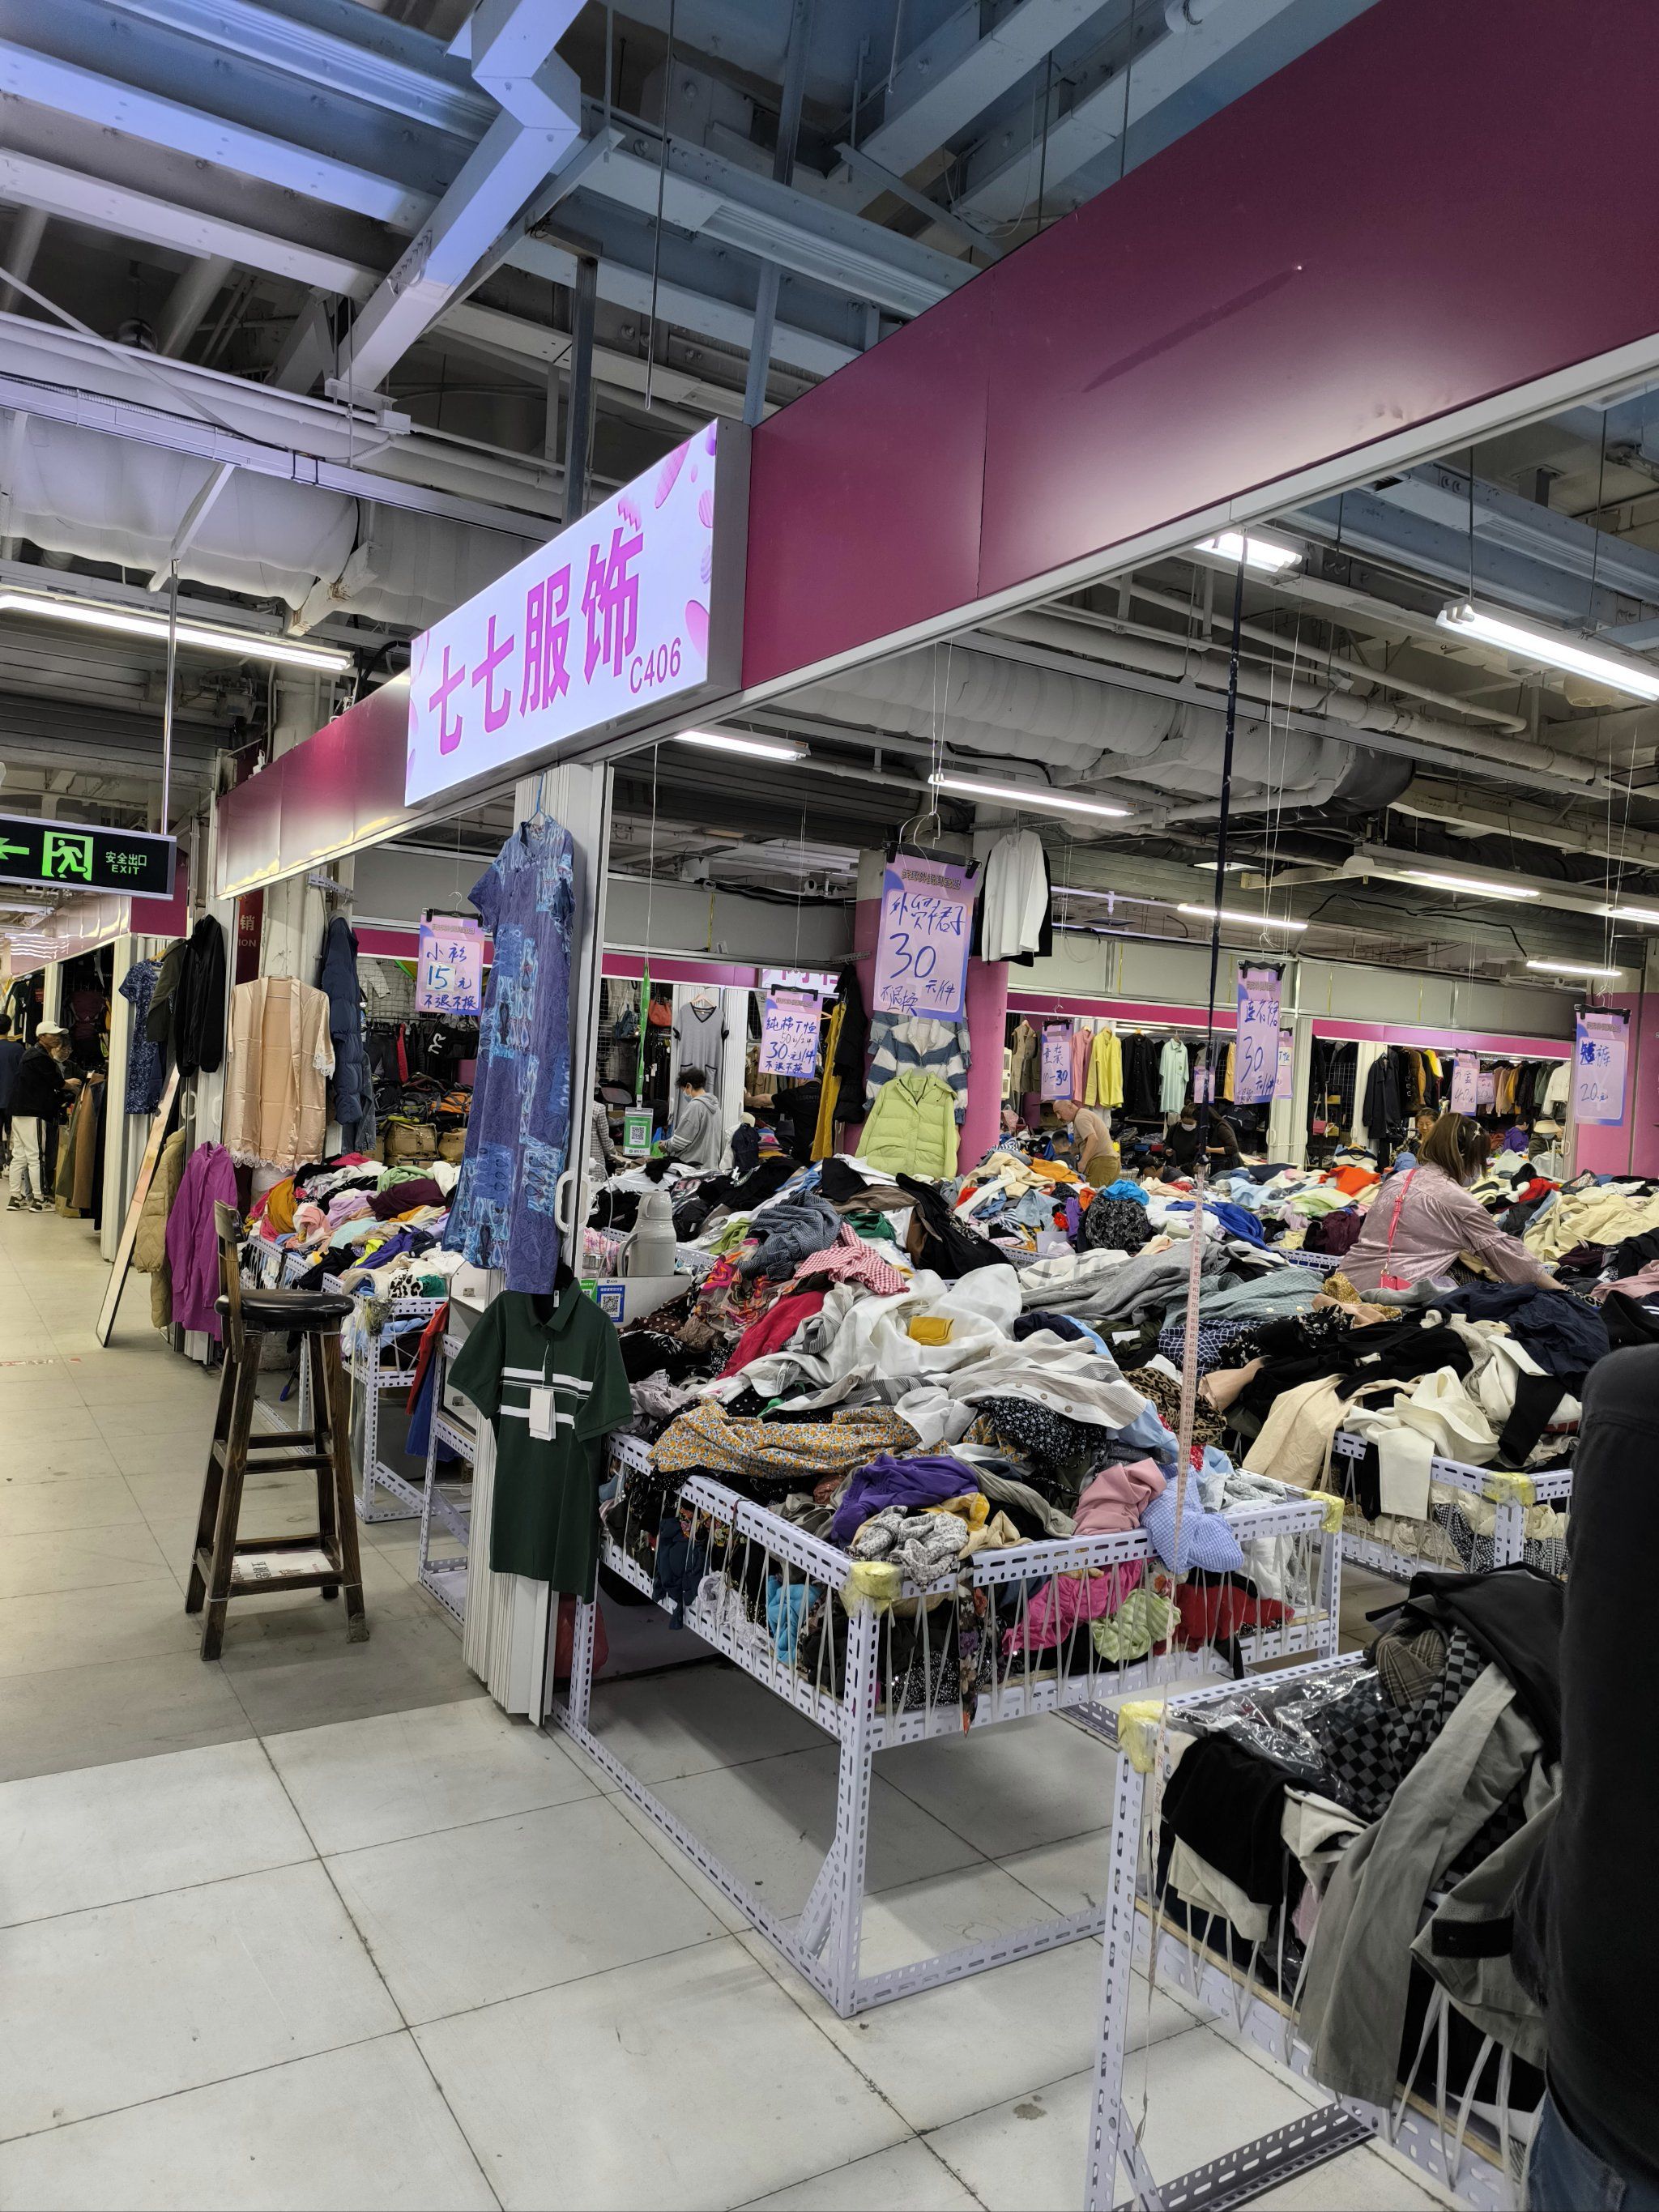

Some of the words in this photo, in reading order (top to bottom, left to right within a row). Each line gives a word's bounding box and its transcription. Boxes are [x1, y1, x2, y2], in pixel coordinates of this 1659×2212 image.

[429, 526, 644, 755] 七七服饰
[629, 637, 681, 694] C406
[105, 851, 147, 867] 安全出口
[111, 864, 140, 875] EXIT
[240, 914, 255, 931] 销
[426, 942, 467, 963] 小衫
[889, 932, 936, 978] 30
[424, 994, 477, 1010] 不退不换
[766, 1016, 817, 1034] 纯棉T恤
[765, 1061, 804, 1074] 不退不换
[1241, 1036, 1264, 1083] 30
